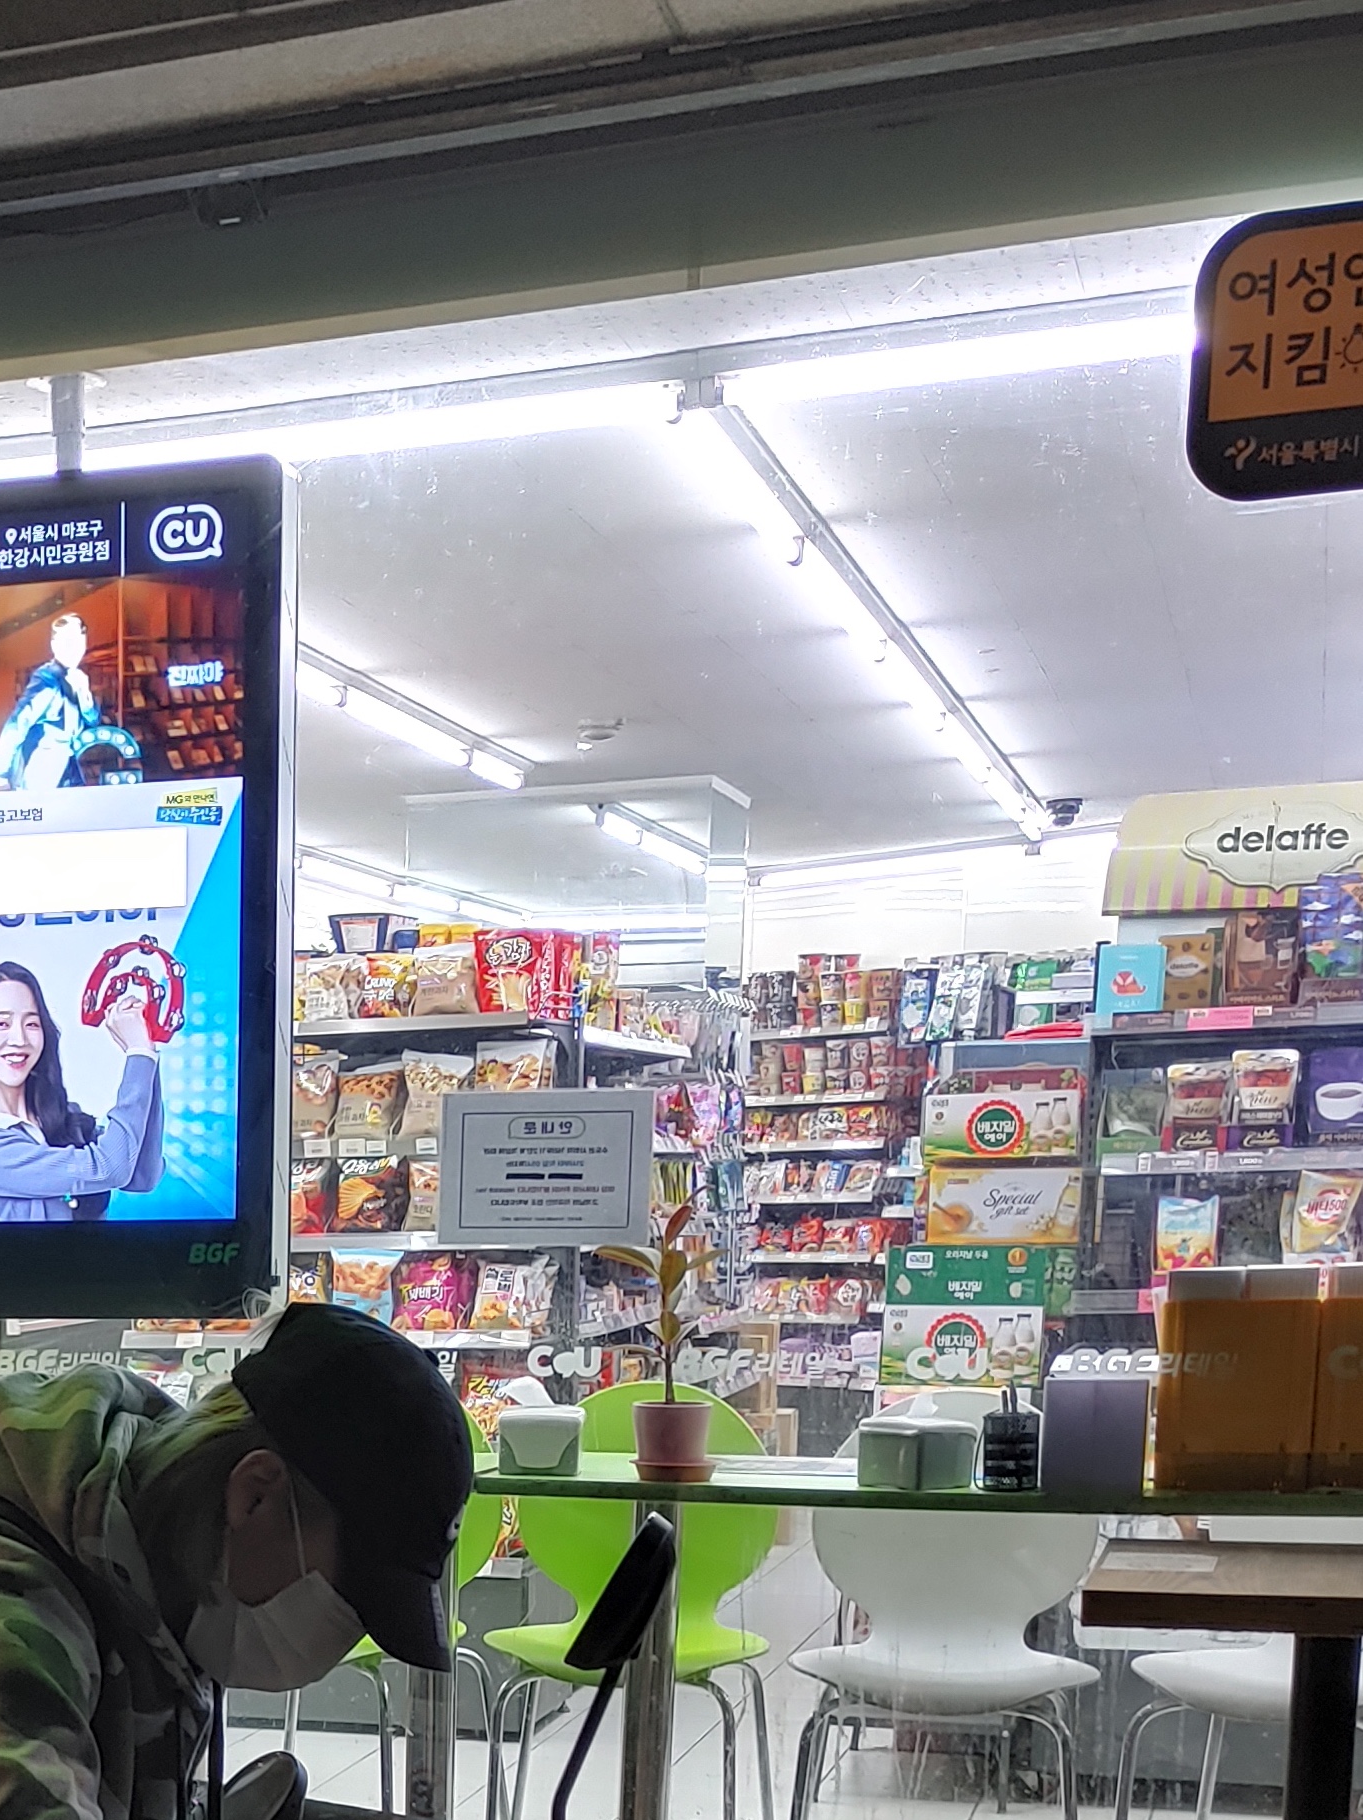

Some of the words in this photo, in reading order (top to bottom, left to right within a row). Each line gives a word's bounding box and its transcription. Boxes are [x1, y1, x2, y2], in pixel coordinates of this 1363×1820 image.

[1257, 435, 1360, 467] 서울특별시
[19, 523, 59, 544] 서울시
[61, 519, 104, 540] 마포구
[163, 517, 208, 548] CU
[1216, 823, 1350, 854] delaffe
[977, 1120, 1016, 1133] 베지밀
[983, 1189, 1043, 1210] Special
[989, 1207, 1012, 1220] gift
[1014, 1207, 1030, 1216] set
[188, 1243, 240, 1265] BGF
[948, 1280, 983, 1292] 베지밀
[936, 1335, 977, 1347] 베지밀
[527, 1345, 602, 1378] CU
[906, 1347, 988, 1381] CU
